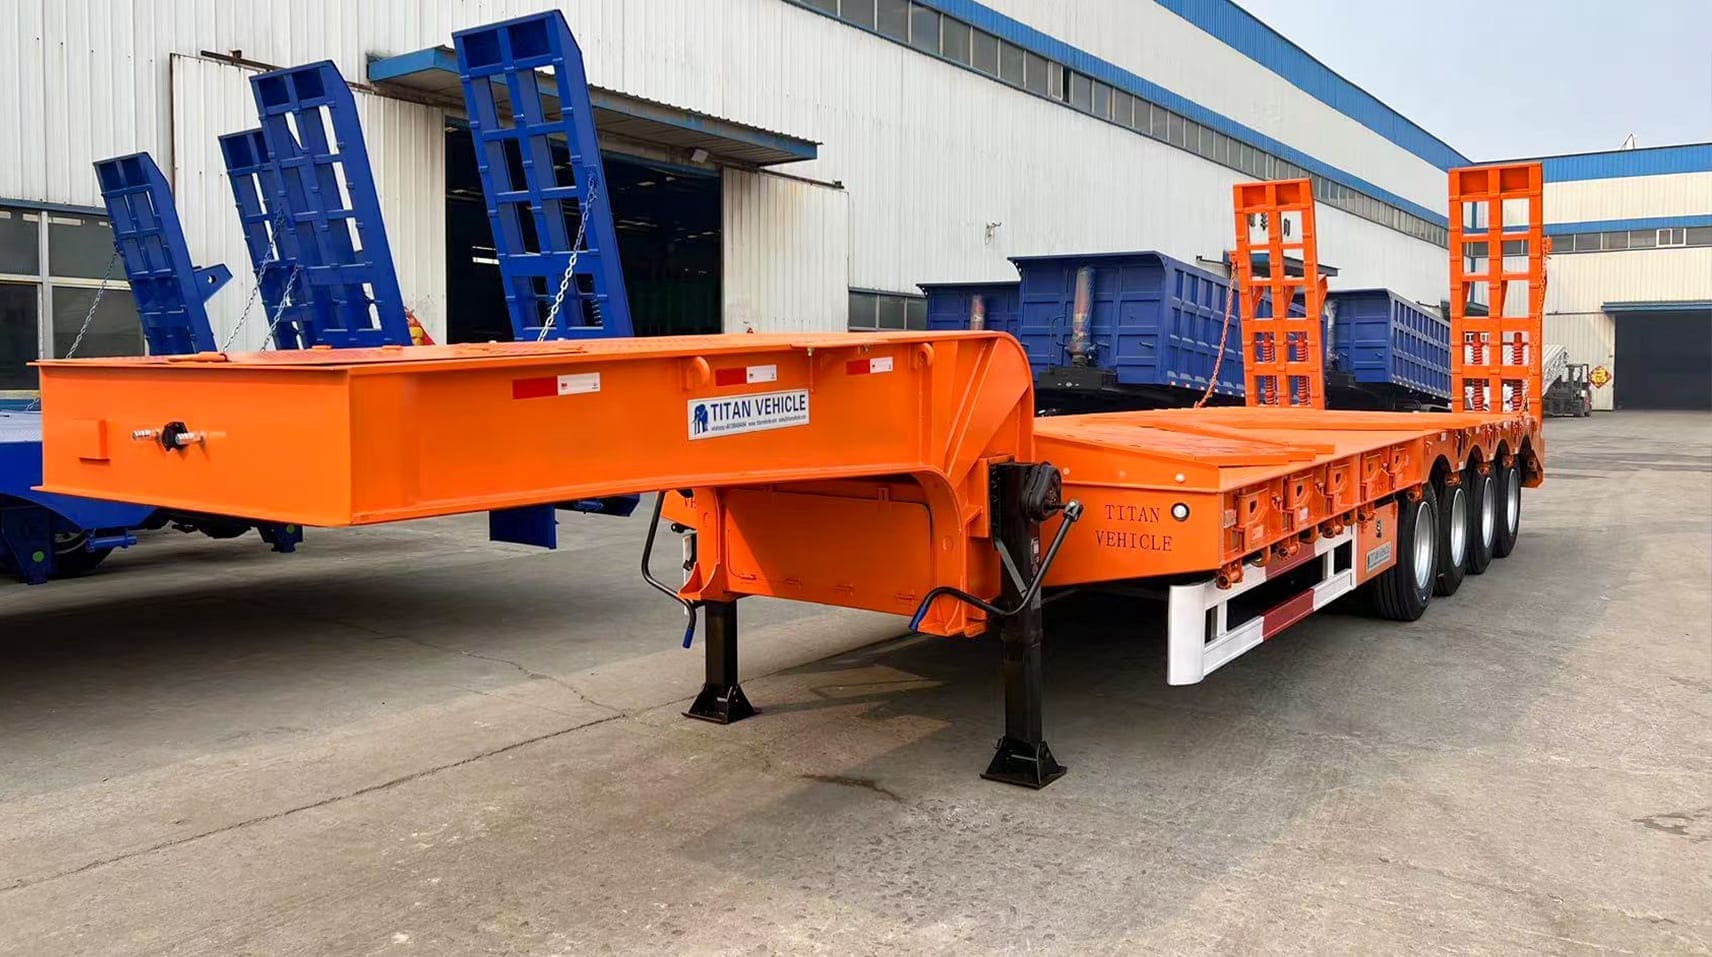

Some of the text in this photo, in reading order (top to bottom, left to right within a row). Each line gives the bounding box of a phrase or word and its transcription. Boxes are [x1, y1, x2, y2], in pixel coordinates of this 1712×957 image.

[710, 394, 806, 421] TITAN VEHICLE
[1104, 504, 1160, 523] TITAN
[1095, 530, 1173, 552] VEHICLE
